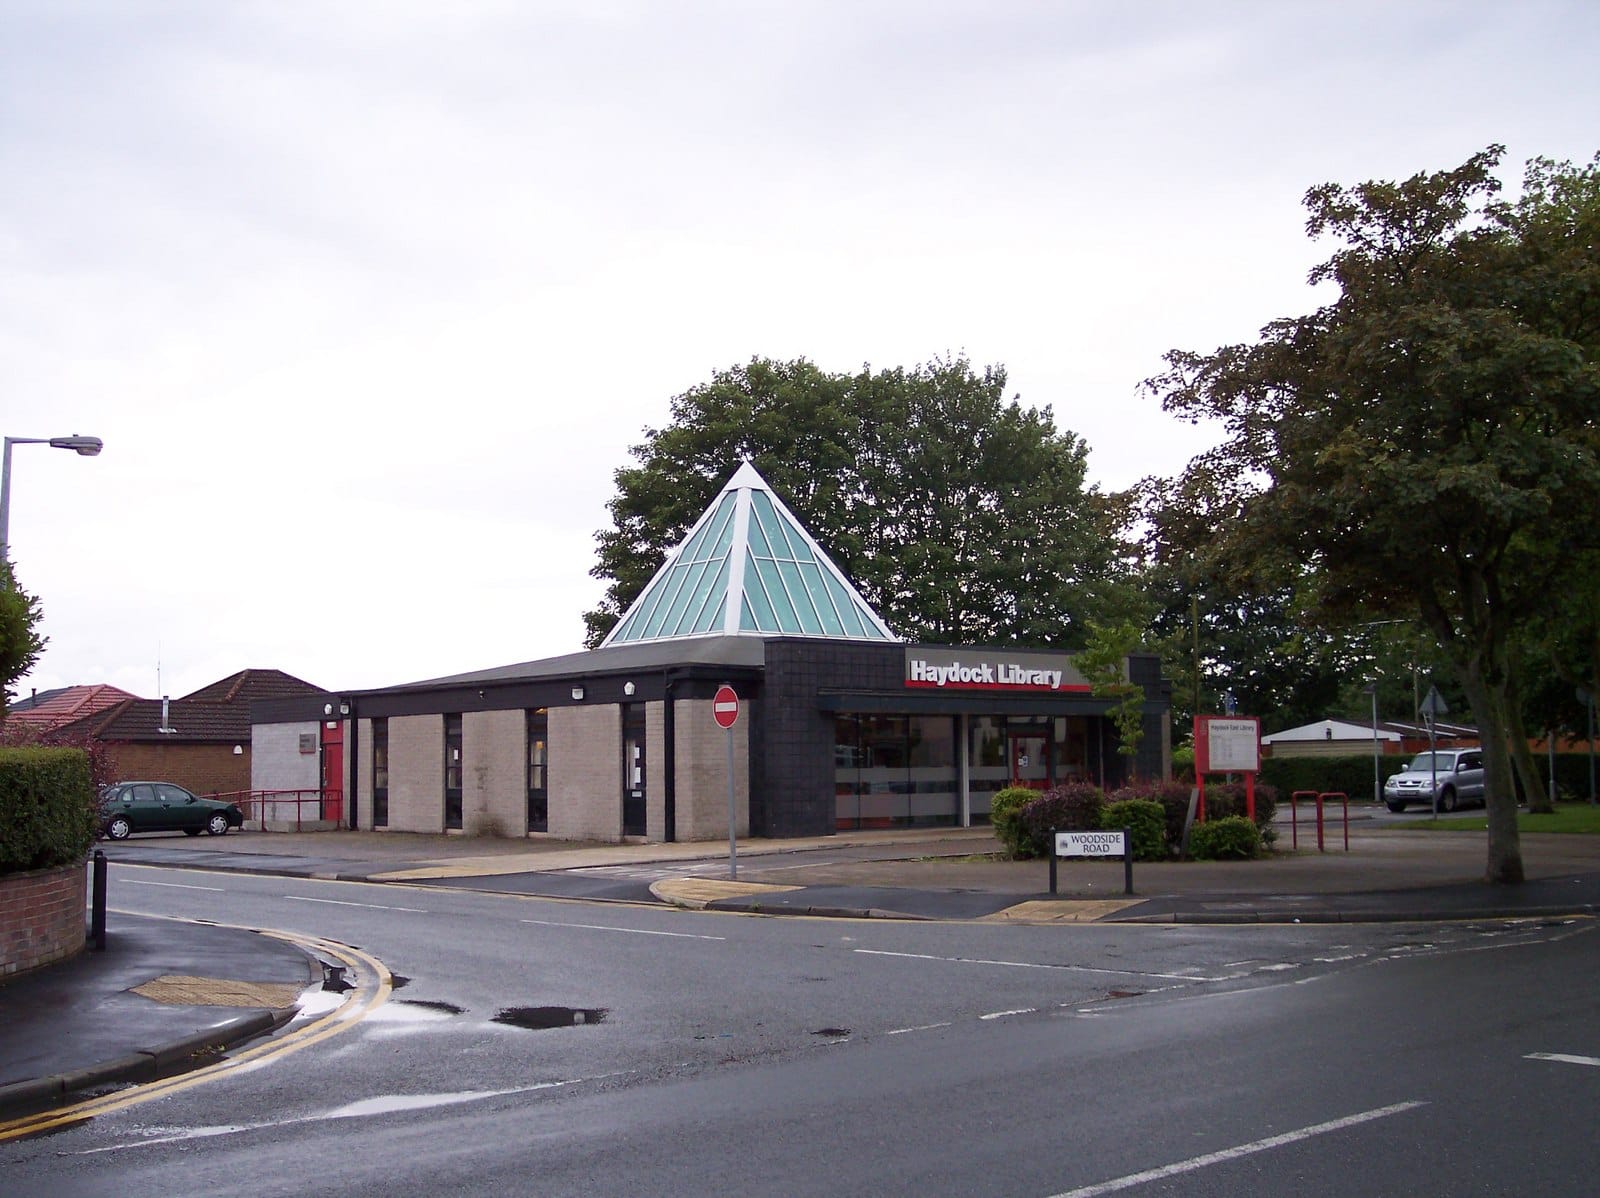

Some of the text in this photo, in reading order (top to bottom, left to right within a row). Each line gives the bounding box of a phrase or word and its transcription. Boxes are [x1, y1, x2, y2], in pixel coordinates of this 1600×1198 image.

[910, 660, 1062, 689] Haydock Library
[1071, 835, 1121, 844] WOODSIDE
[1083, 844, 1110, 853] ROAD
